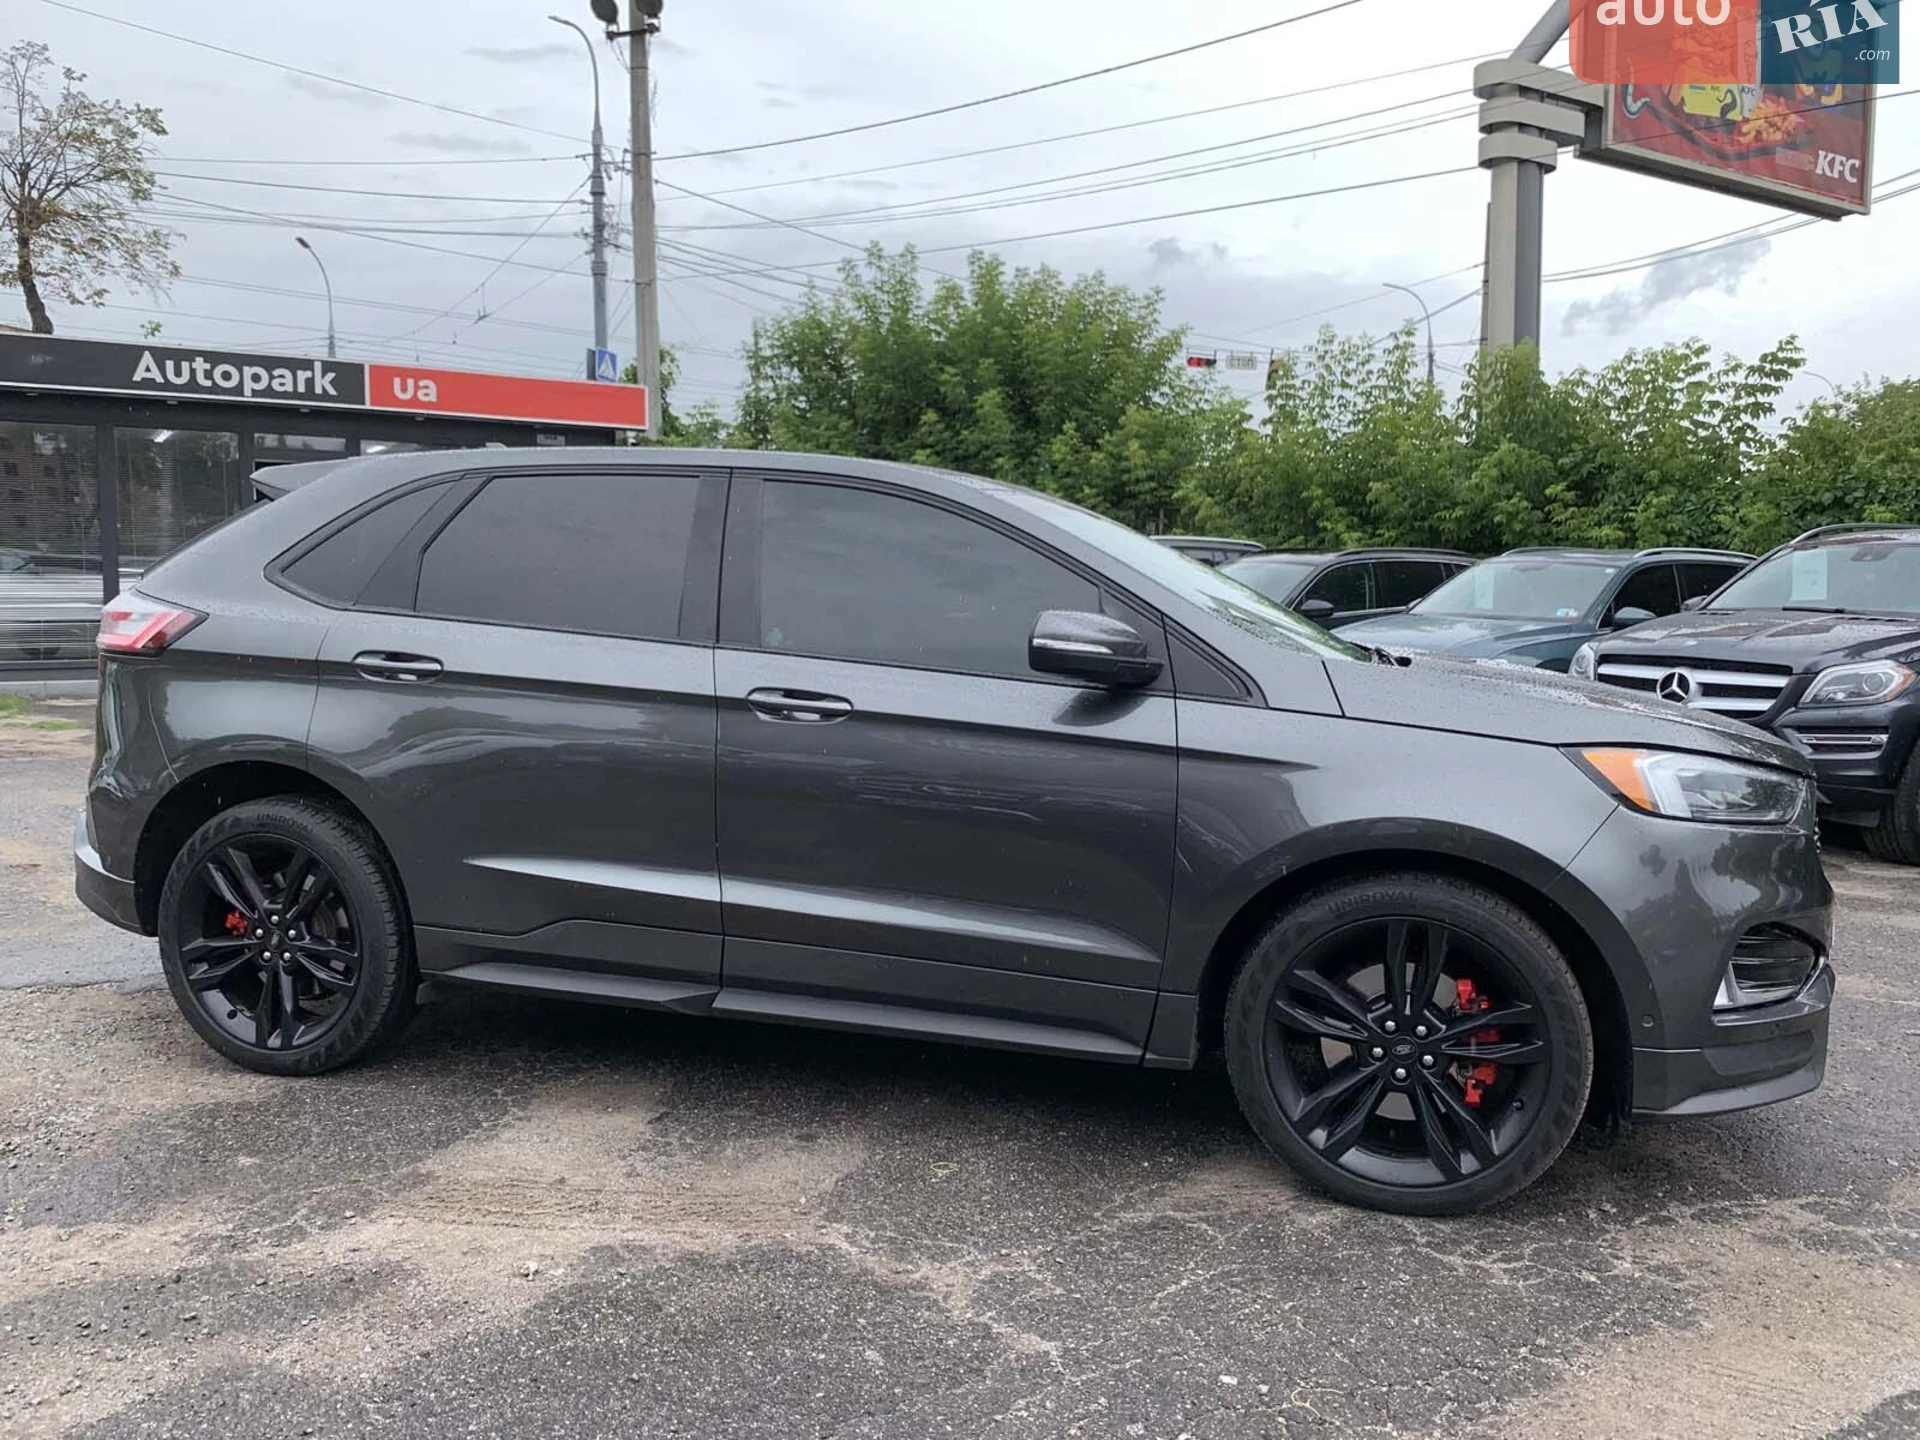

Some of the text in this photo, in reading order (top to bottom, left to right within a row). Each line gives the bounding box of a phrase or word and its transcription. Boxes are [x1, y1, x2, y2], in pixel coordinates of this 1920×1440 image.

[1815, 149, 1860, 183] KFC
[132, 350, 338, 396] Autopark
[393, 376, 437, 402] ua
